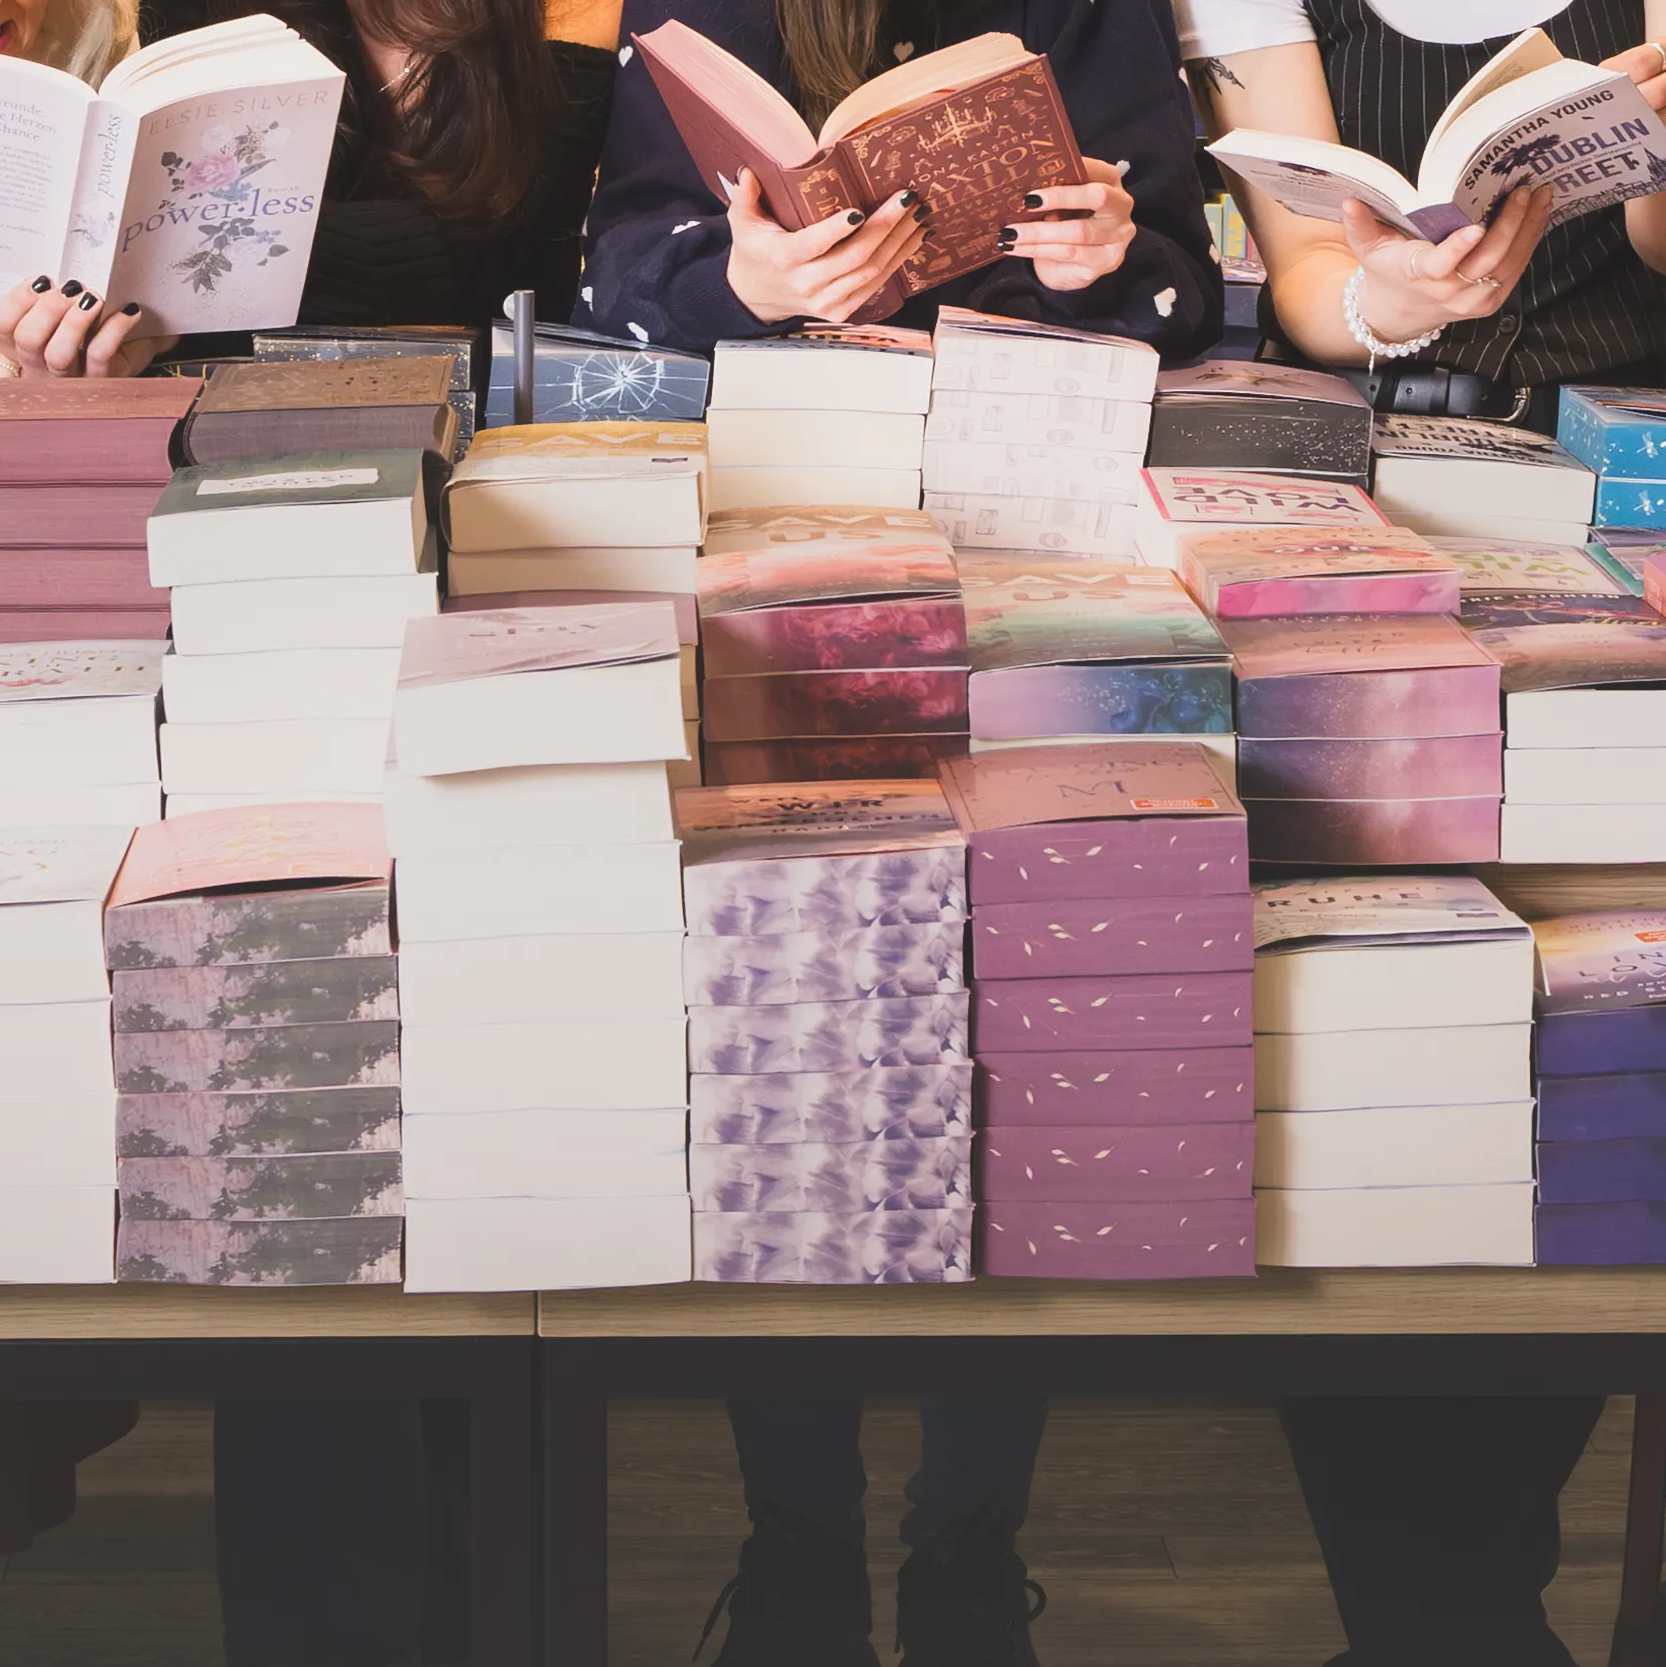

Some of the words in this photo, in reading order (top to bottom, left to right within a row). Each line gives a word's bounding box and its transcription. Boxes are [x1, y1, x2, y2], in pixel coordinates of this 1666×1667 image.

[148, 103, 218, 137] ELSIE
[233, 90, 329, 114] SILVER
[1465, 116, 1550, 190] SAMANTHA
[1551, 90, 1614, 120] YOUNG
[1530, 117, 1651, 176] DUBLIN
